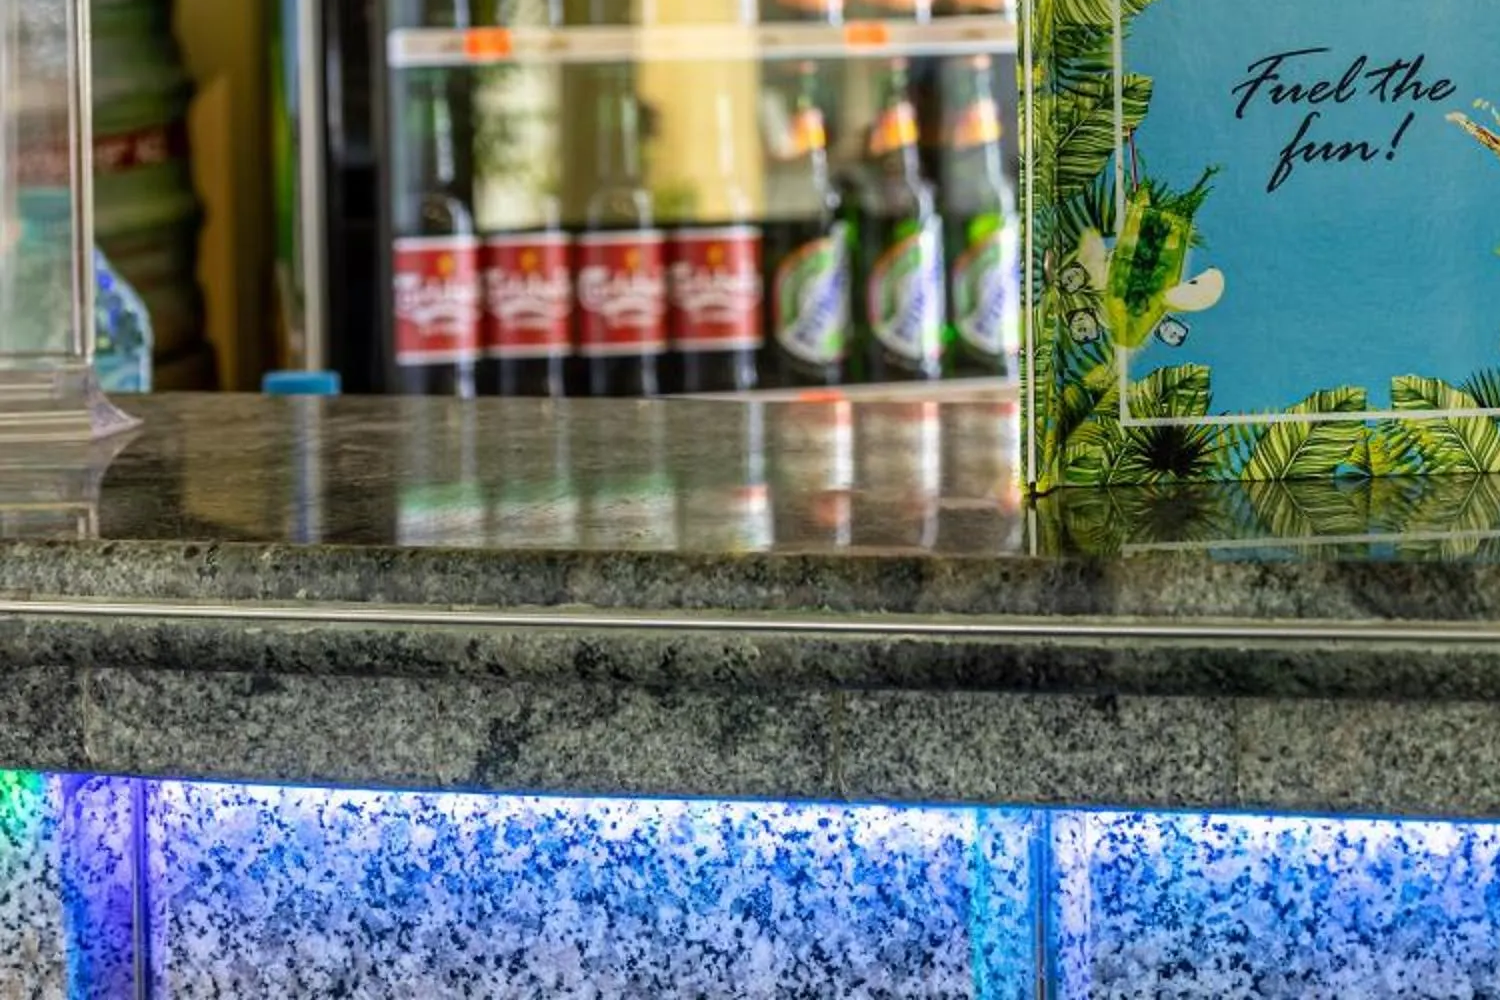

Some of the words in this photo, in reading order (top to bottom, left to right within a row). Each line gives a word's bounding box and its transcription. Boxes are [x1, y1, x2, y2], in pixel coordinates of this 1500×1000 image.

[1231, 47, 1368, 119] Fuel
[1364, 53, 1457, 103] the
[1266, 111, 1416, 193] fun!
